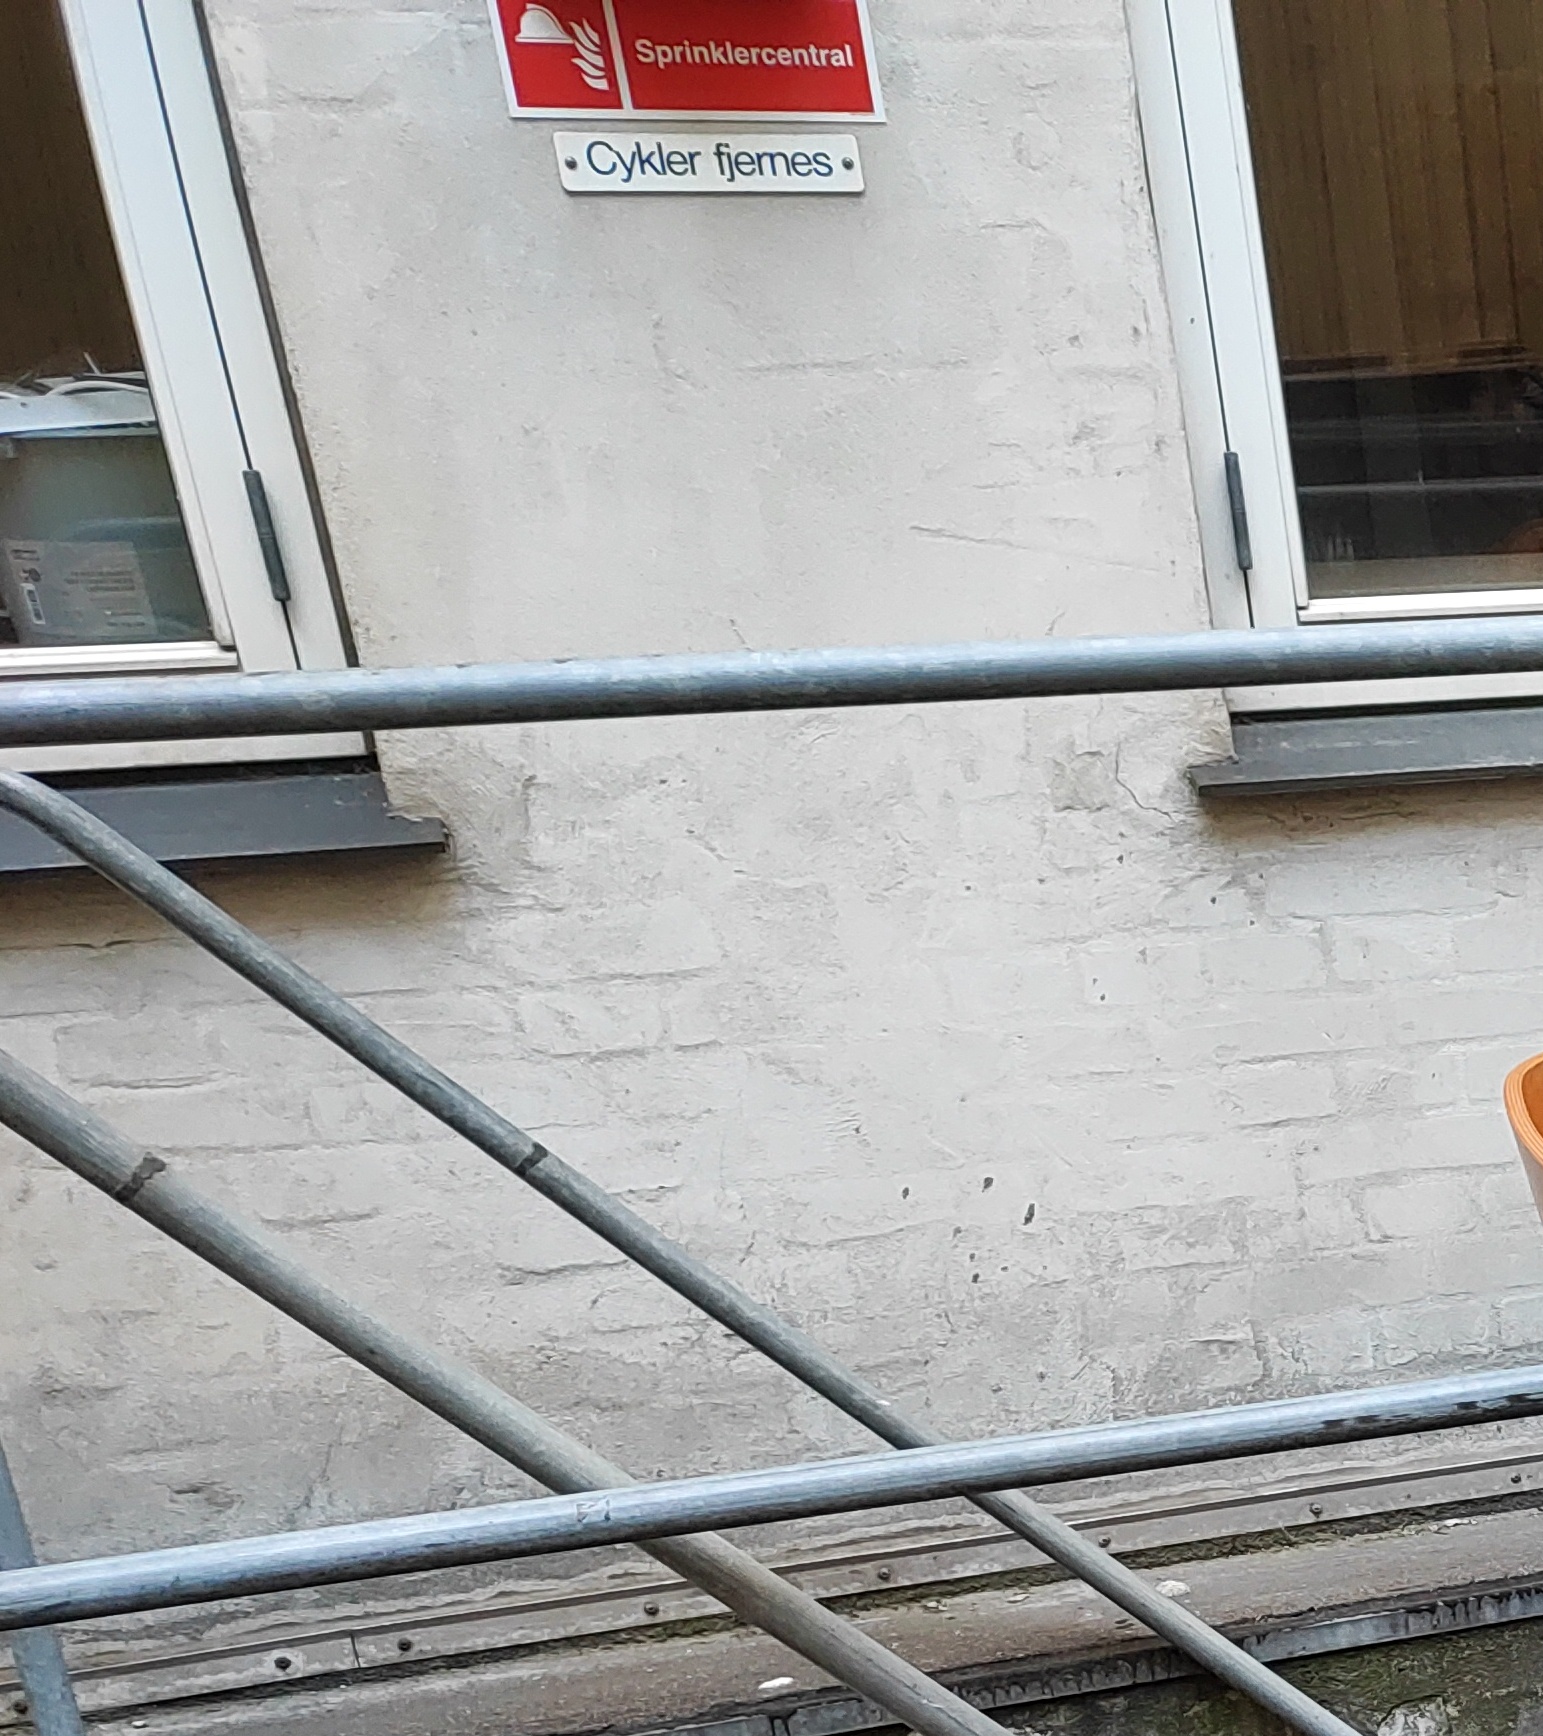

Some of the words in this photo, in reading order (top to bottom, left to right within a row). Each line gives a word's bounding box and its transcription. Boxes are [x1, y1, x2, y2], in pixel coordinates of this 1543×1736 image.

[636, 38, 853, 69] Sprinklercentral
[585, 140, 700, 183] Cykler
[713, 142, 834, 183] fjernes
